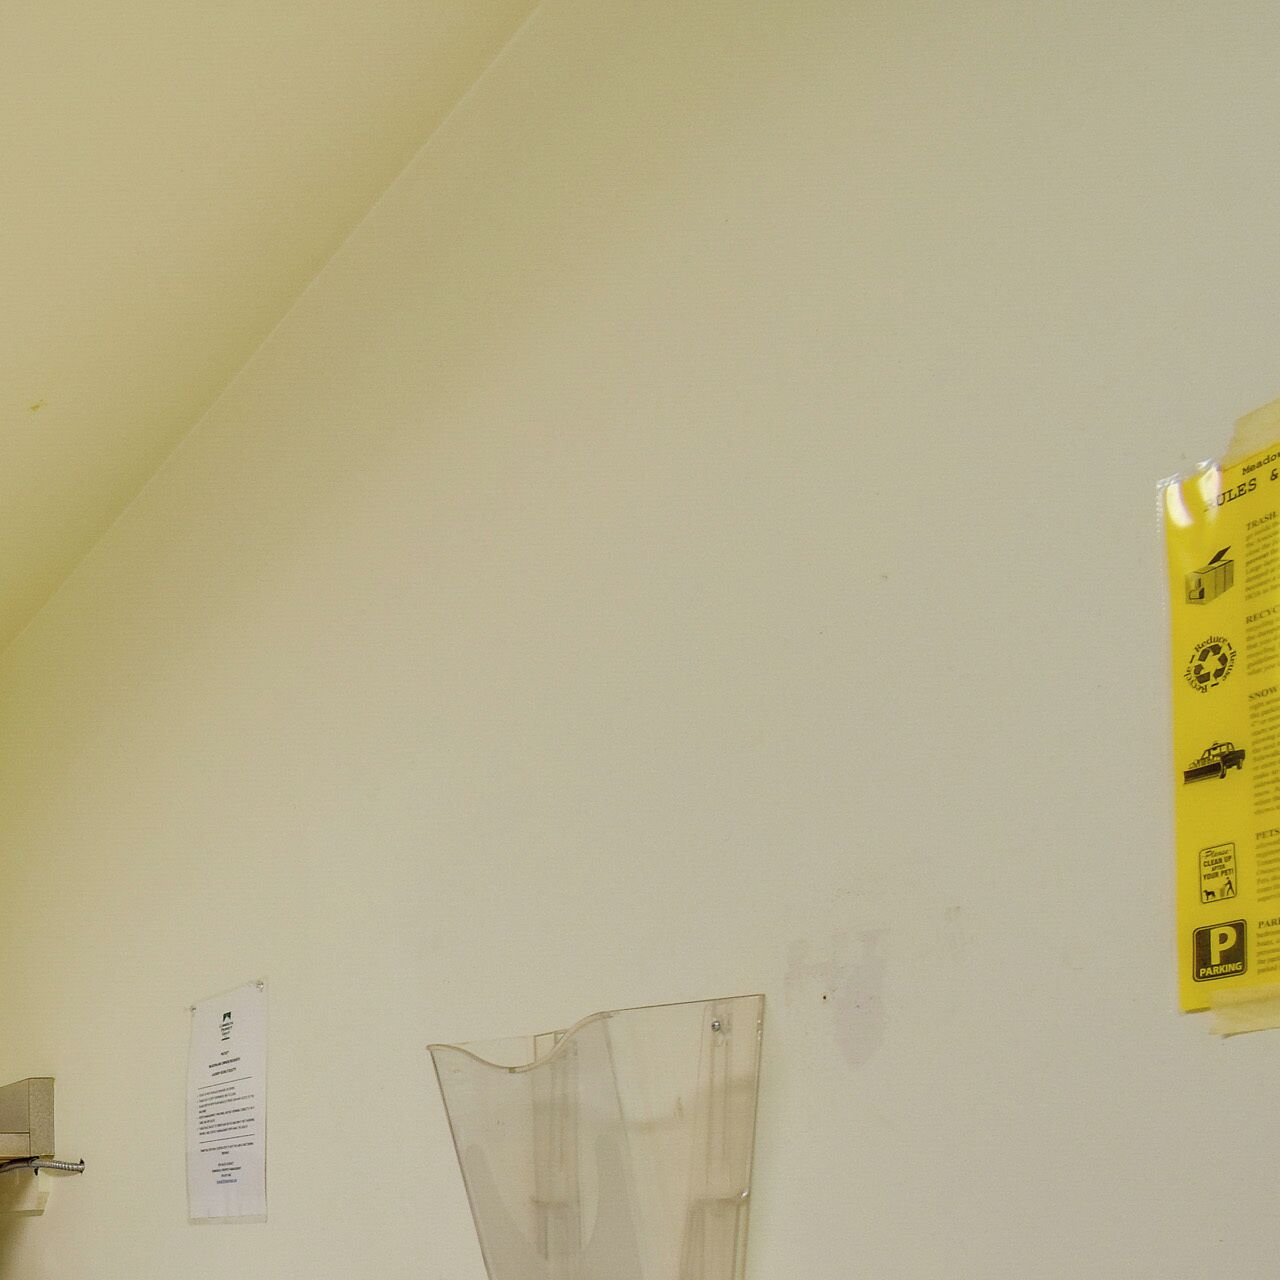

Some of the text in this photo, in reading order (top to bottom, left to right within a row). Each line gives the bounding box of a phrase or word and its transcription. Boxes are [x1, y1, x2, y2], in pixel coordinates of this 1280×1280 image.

[1204, 469, 1278, 512] ULES &
[1195, 636, 1228, 652] Reduce
[1222, 650, 1236, 681] Reuse
[1184, 666, 1208, 693] Recycle
[1203, 858, 1222, 868] CLEAN
[1203, 872, 1219, 880] YOUR
[1210, 926, 1236, 965] P
[1200, 962, 1242, 977] PARKING
